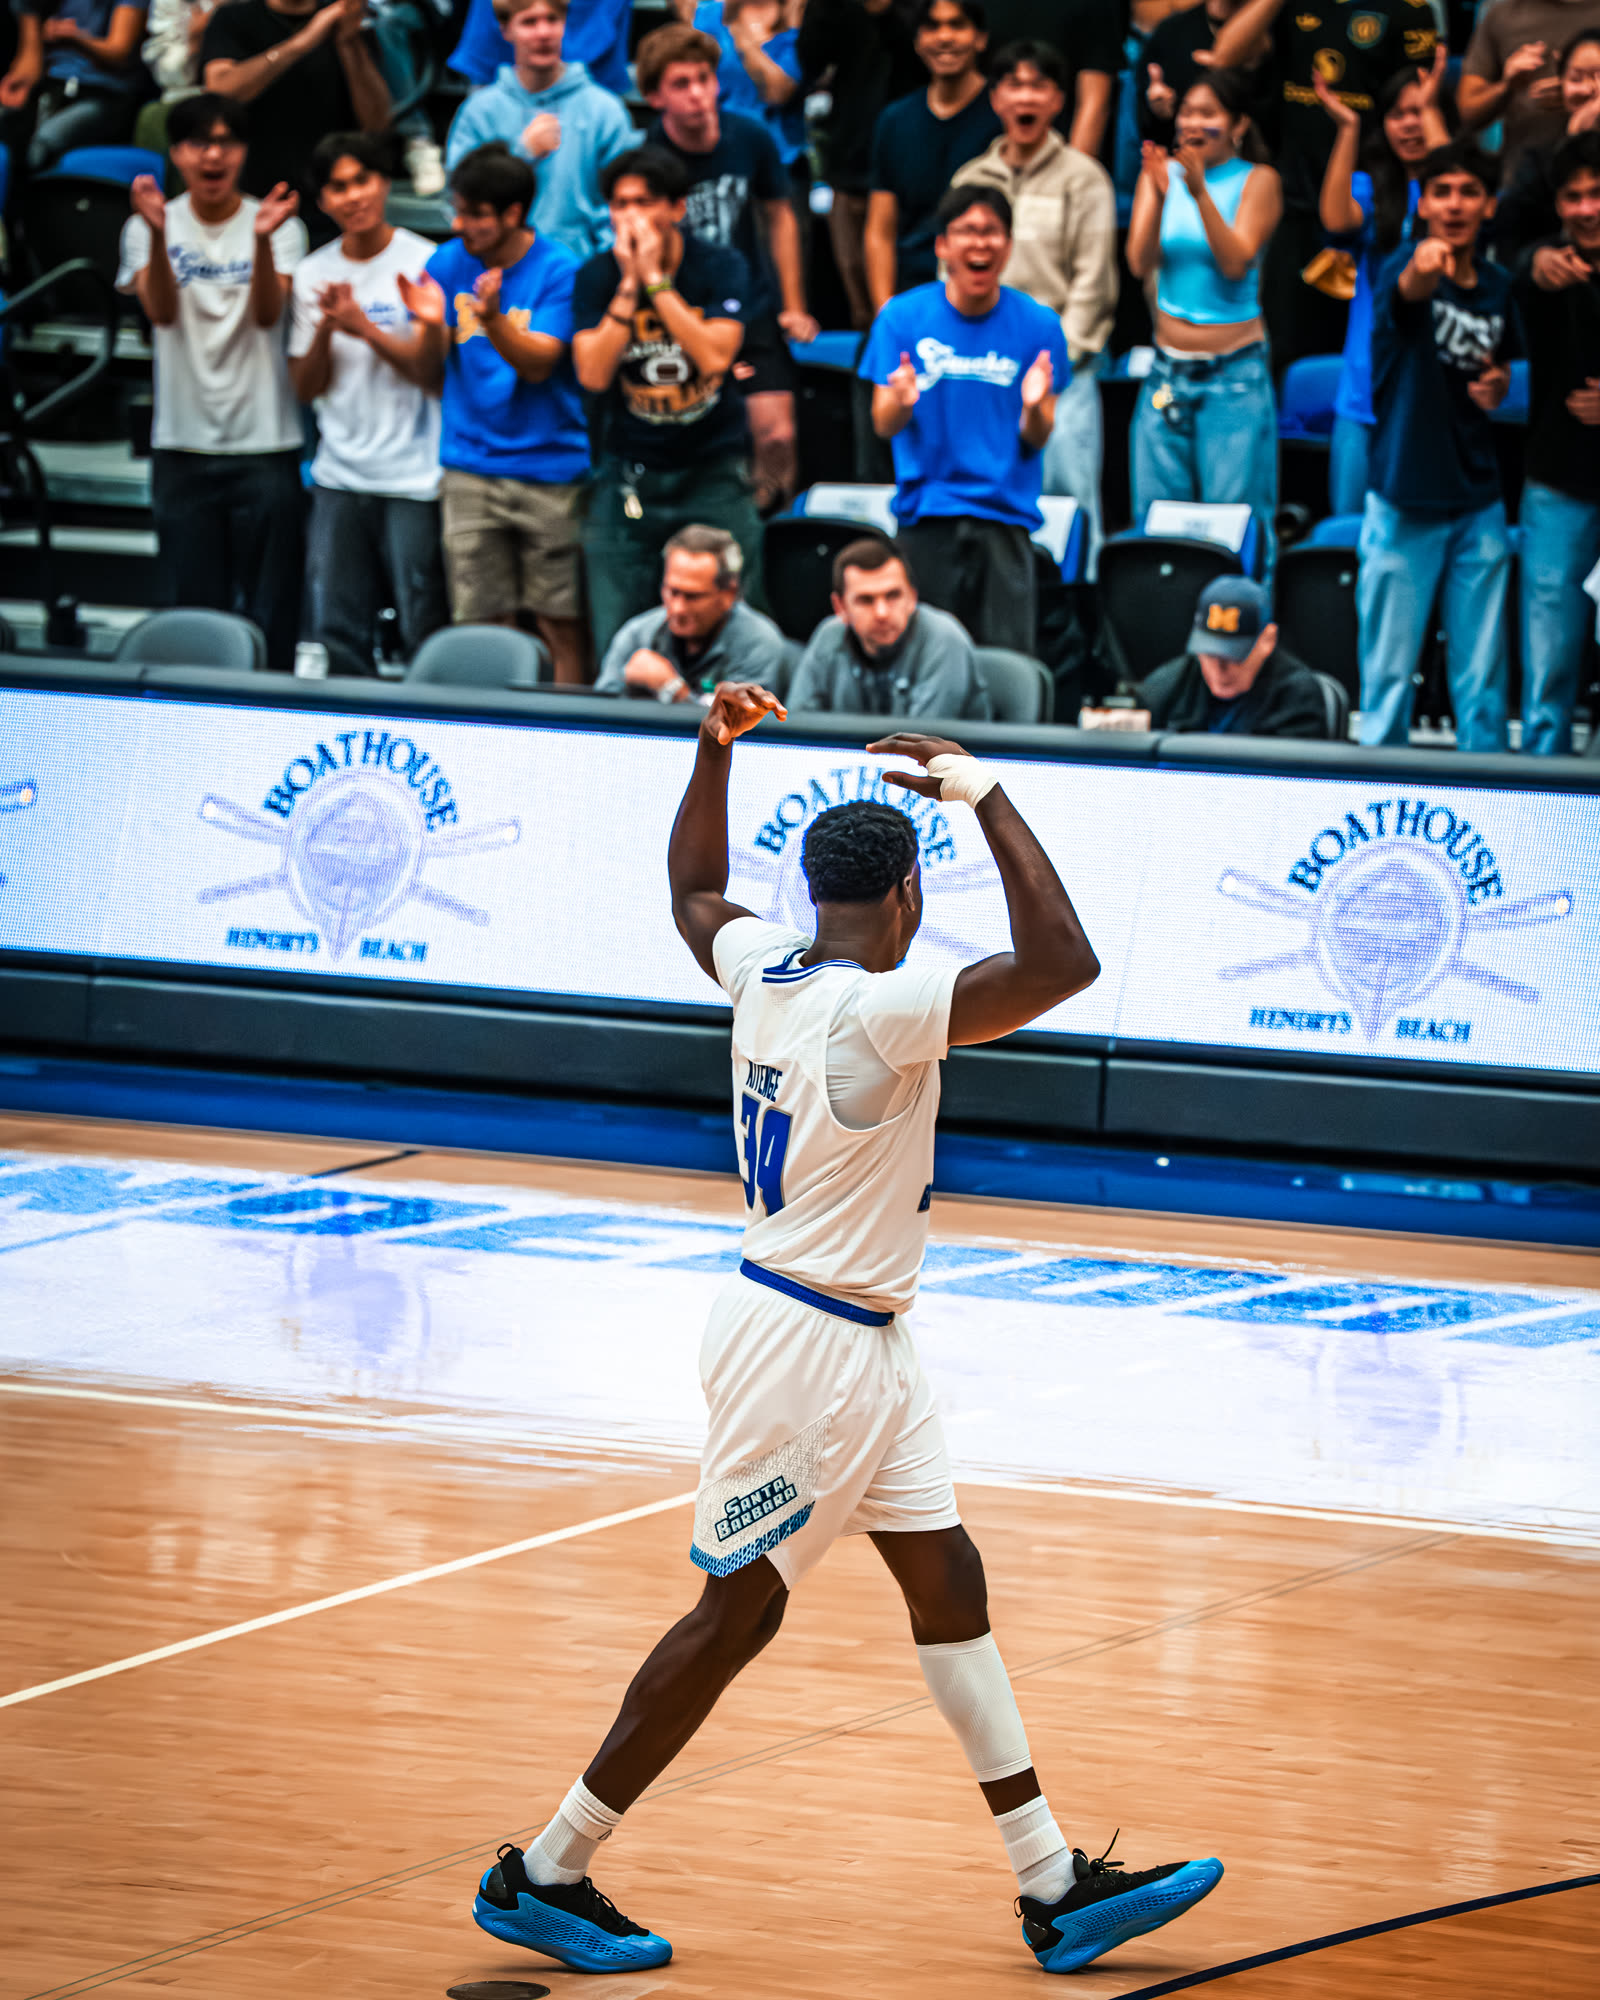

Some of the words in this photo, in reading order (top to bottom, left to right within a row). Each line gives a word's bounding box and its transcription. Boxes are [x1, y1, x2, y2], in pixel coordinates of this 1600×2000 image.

[264, 730, 458, 832] BOATHOUSE
[1288, 798, 1503, 904] BOATHOUSE
[1396, 1018, 1471, 1043] BEACH
[716, 1485, 796, 1541] BARBARA
[725, 1476, 785, 1519] SANTA
